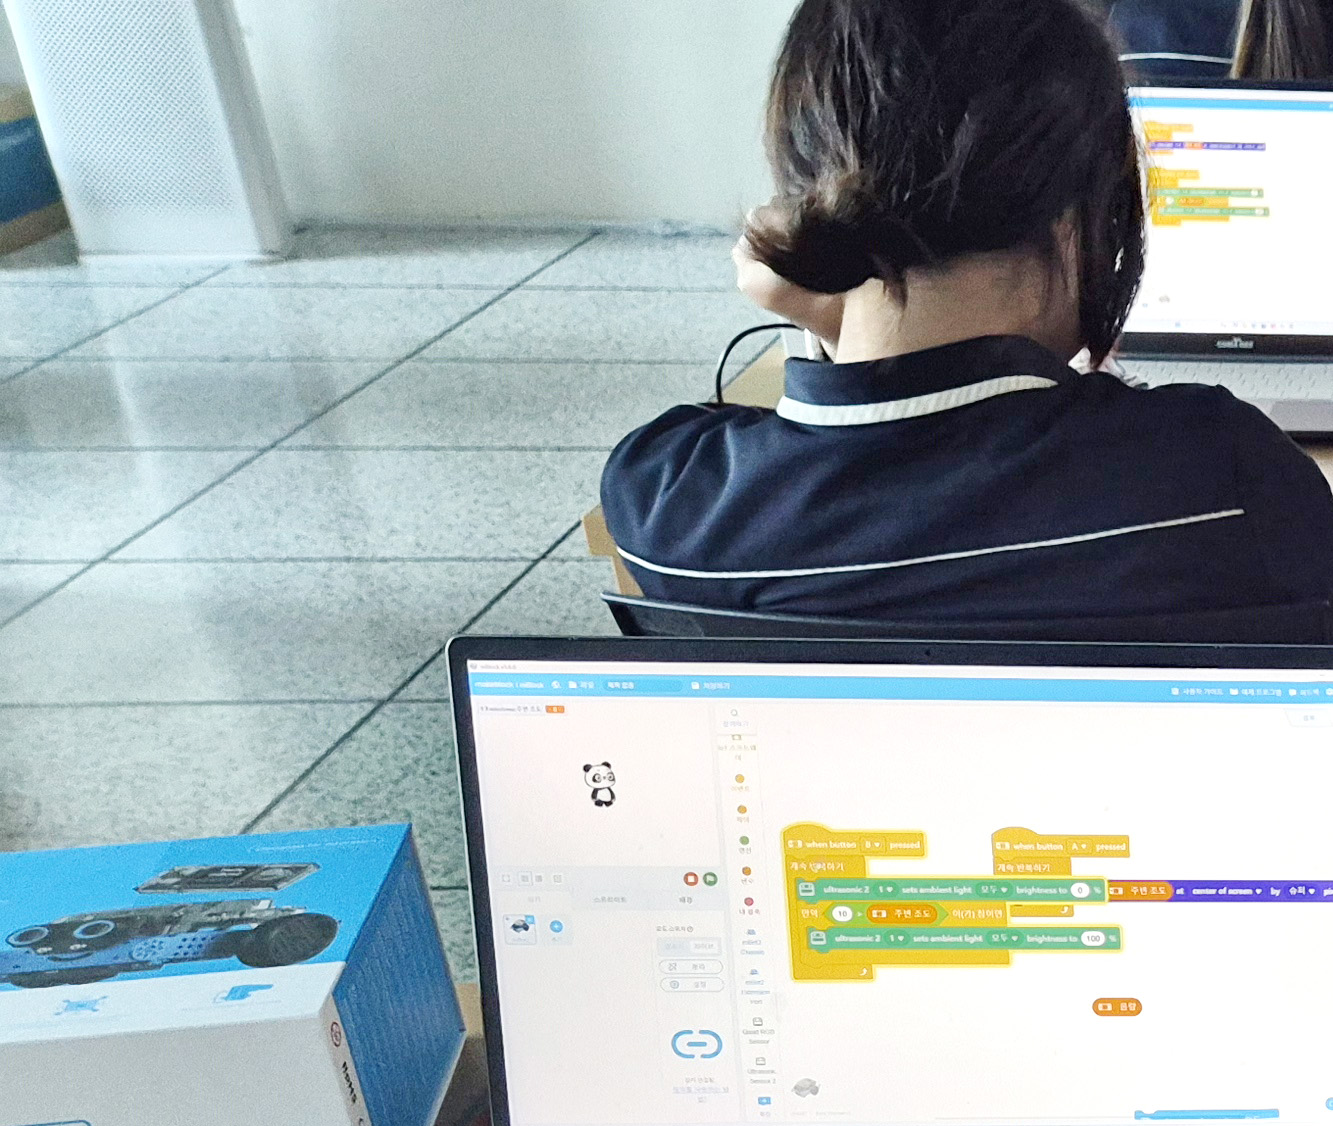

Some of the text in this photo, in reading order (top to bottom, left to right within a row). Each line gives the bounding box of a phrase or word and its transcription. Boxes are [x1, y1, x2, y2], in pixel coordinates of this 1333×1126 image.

[805, 840, 828, 849] when
[829, 840, 856, 849] button
[889, 840, 921, 850] pressed
[1013, 842, 1035, 851] when
[1036, 842, 1063, 851] button
[1096, 843, 1126, 852] pressed
